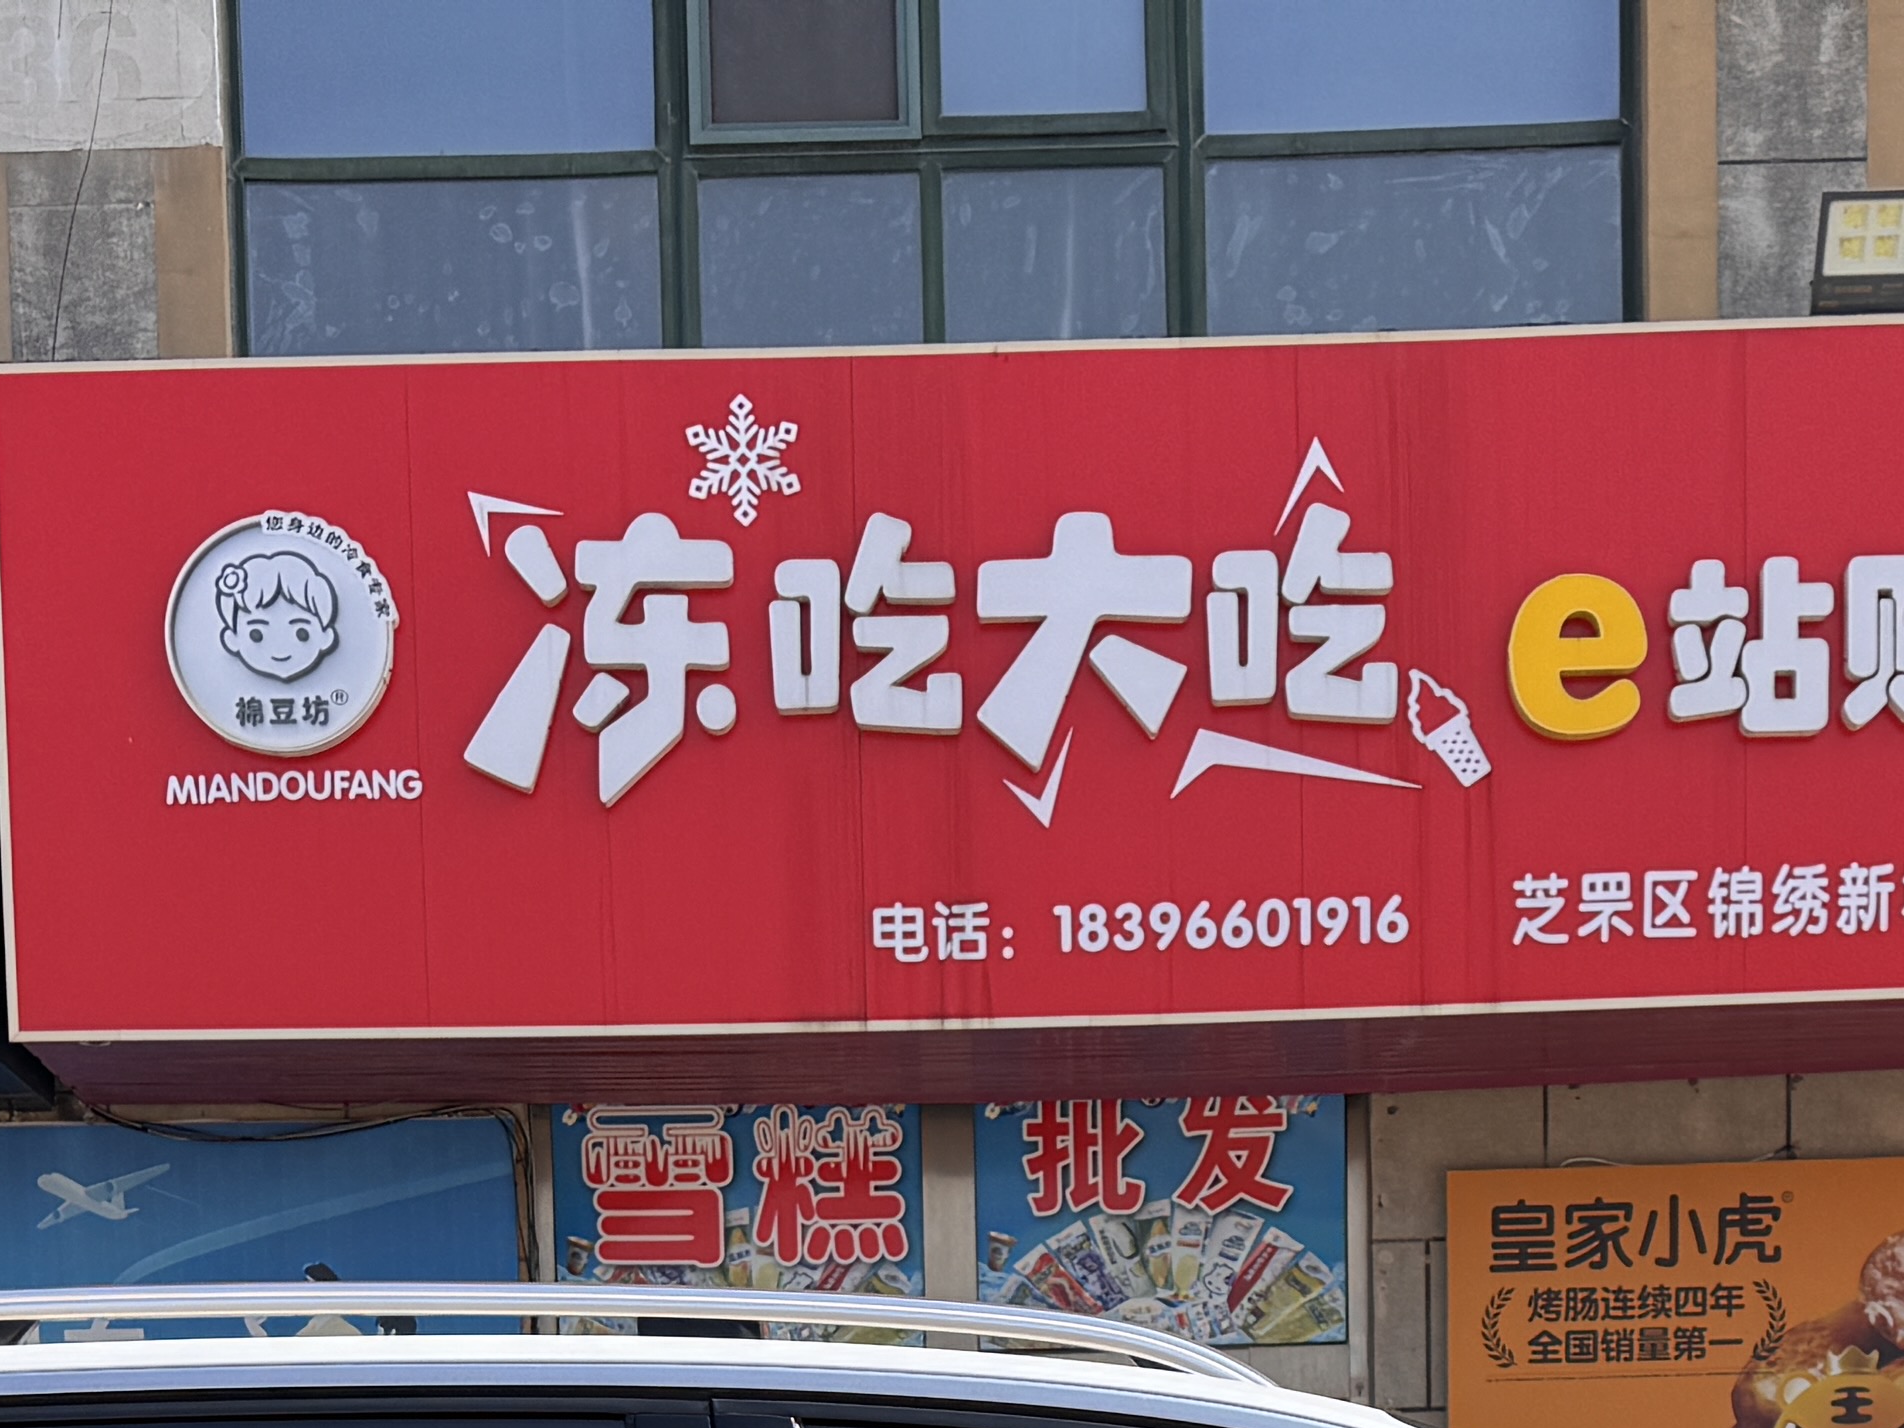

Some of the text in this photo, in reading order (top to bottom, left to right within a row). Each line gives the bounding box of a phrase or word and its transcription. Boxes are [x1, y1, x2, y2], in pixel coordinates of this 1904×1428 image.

[463, 502, 1398, 808] 冻吃大吃
[235, 696, 330, 727] 棉豆坊
[166, 769, 423, 806] MIANDOUFANG
[1053, 894, 1410, 954] 18396601916
[583, 1103, 908, 1269] 雪糕
[1021, 1095, 1295, 1218] 批发
[1487, 1191, 1783, 1274] 皇家小虎
[1526, 1282, 1746, 1323] 烤肠连续四年
[1526, 1325, 1745, 1366] 全国销量第一
